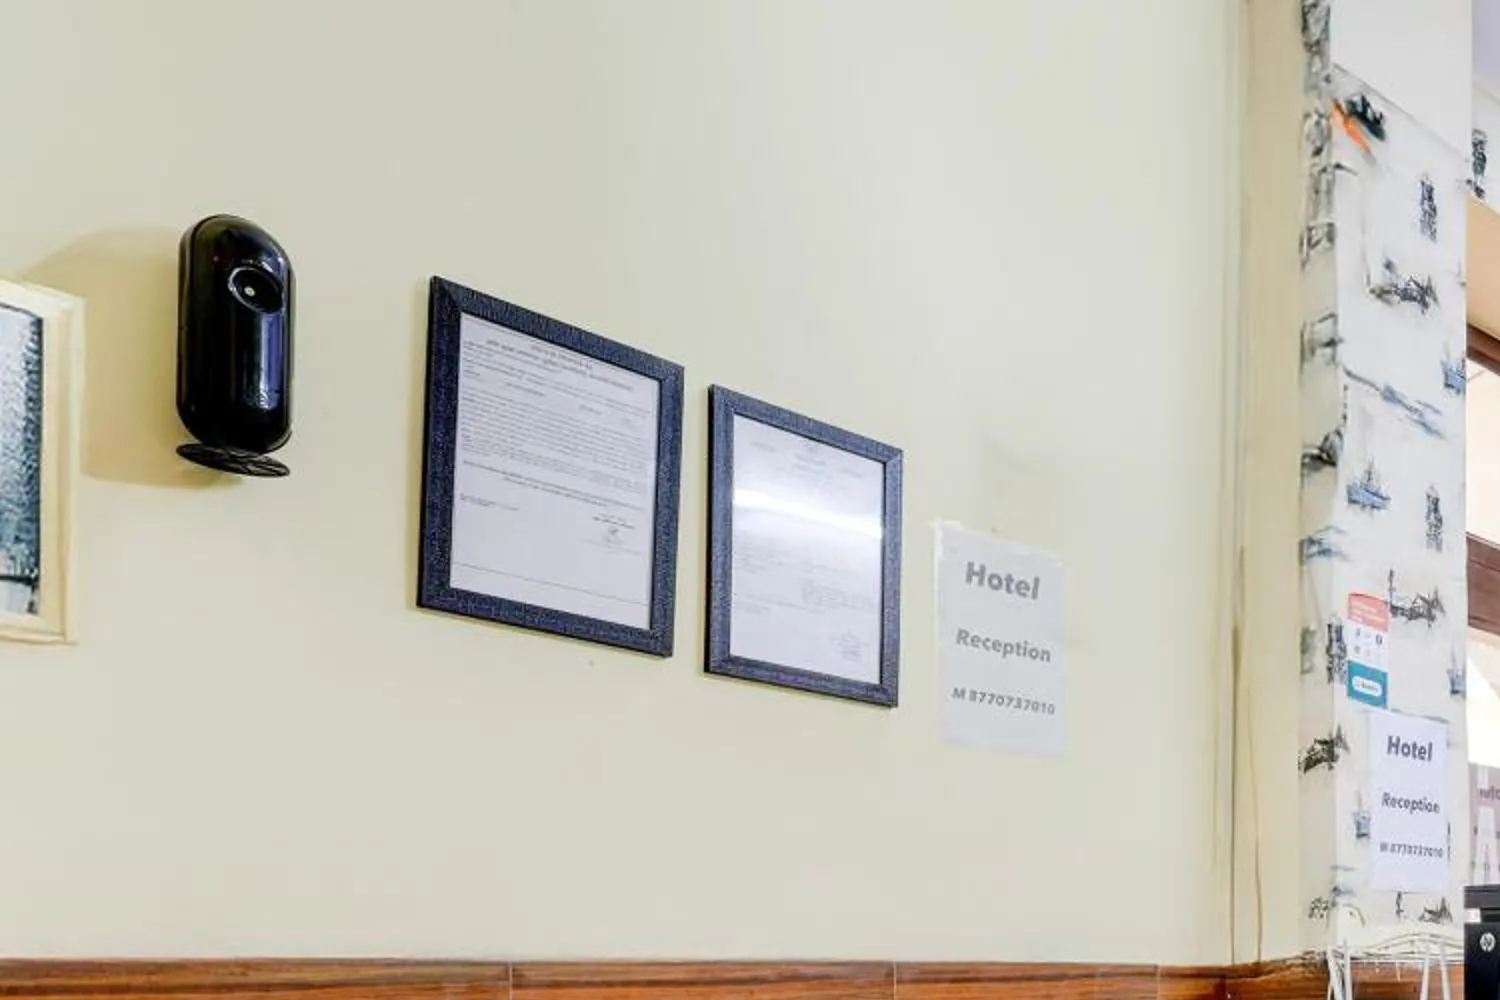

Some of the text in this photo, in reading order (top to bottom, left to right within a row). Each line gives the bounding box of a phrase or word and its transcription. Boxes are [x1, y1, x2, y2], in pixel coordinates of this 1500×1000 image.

[965, 561, 1040, 600] Hotel
[955, 627, 1052, 663] Reception
[1386, 735, 1433, 762] Hotel
[1381, 791, 1440, 814] Reception
